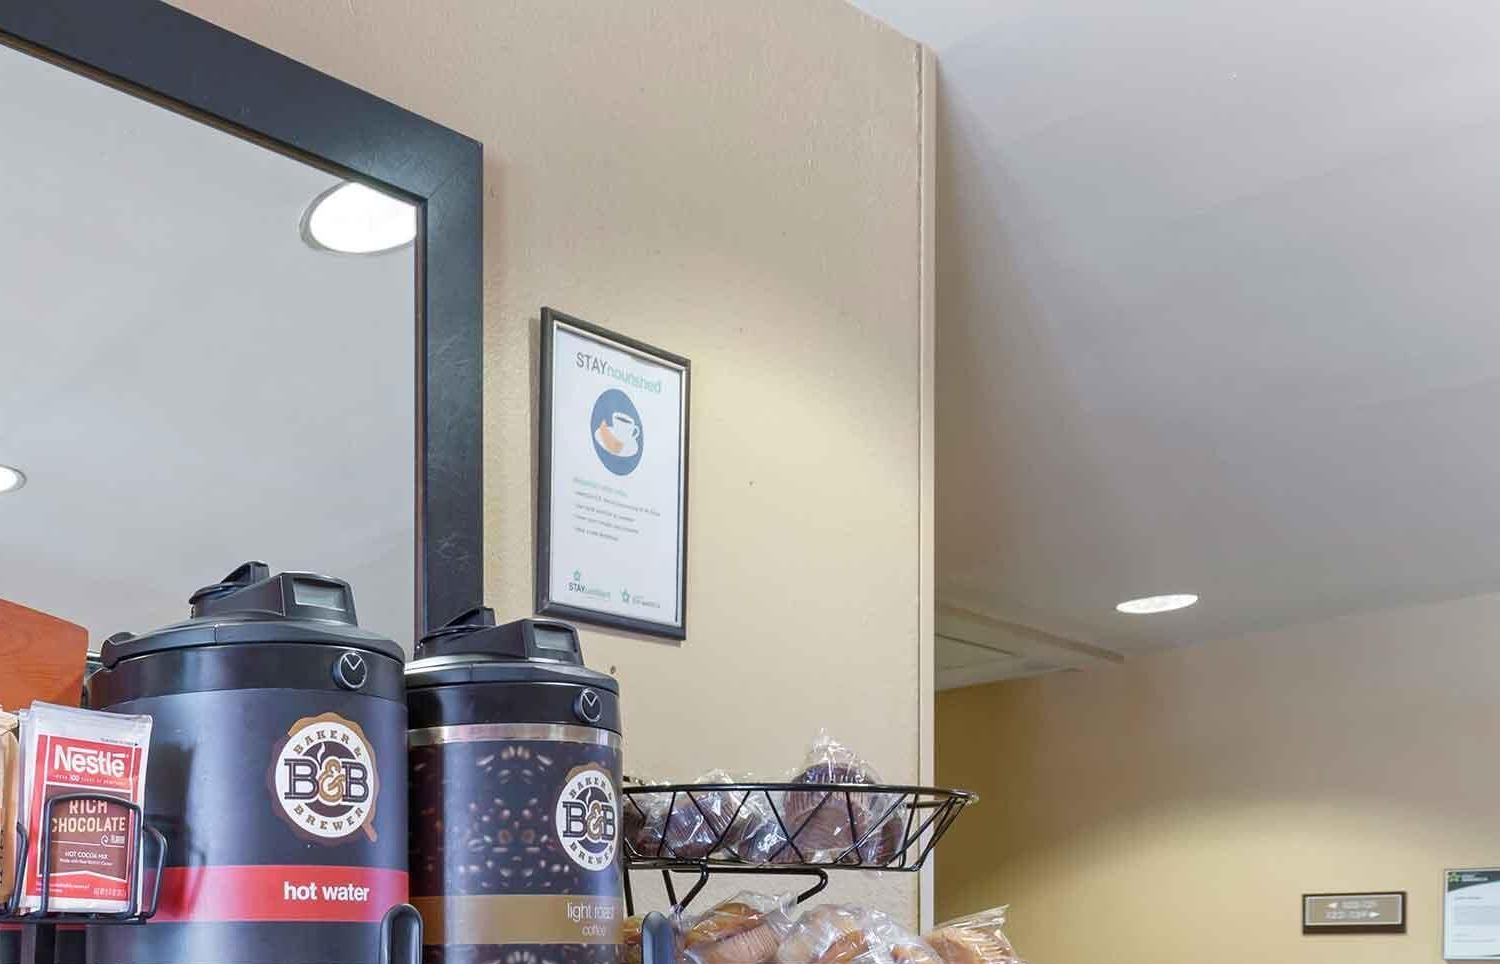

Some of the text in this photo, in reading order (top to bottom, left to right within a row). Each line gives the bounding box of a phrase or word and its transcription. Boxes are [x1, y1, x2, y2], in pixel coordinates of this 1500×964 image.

[293, 729, 351, 754] BAKER
[284, 758, 370, 803] B&B
[293, 804, 364, 832] BREWER
[284, 881, 370, 902] hot water
[567, 902, 592, 922] light
